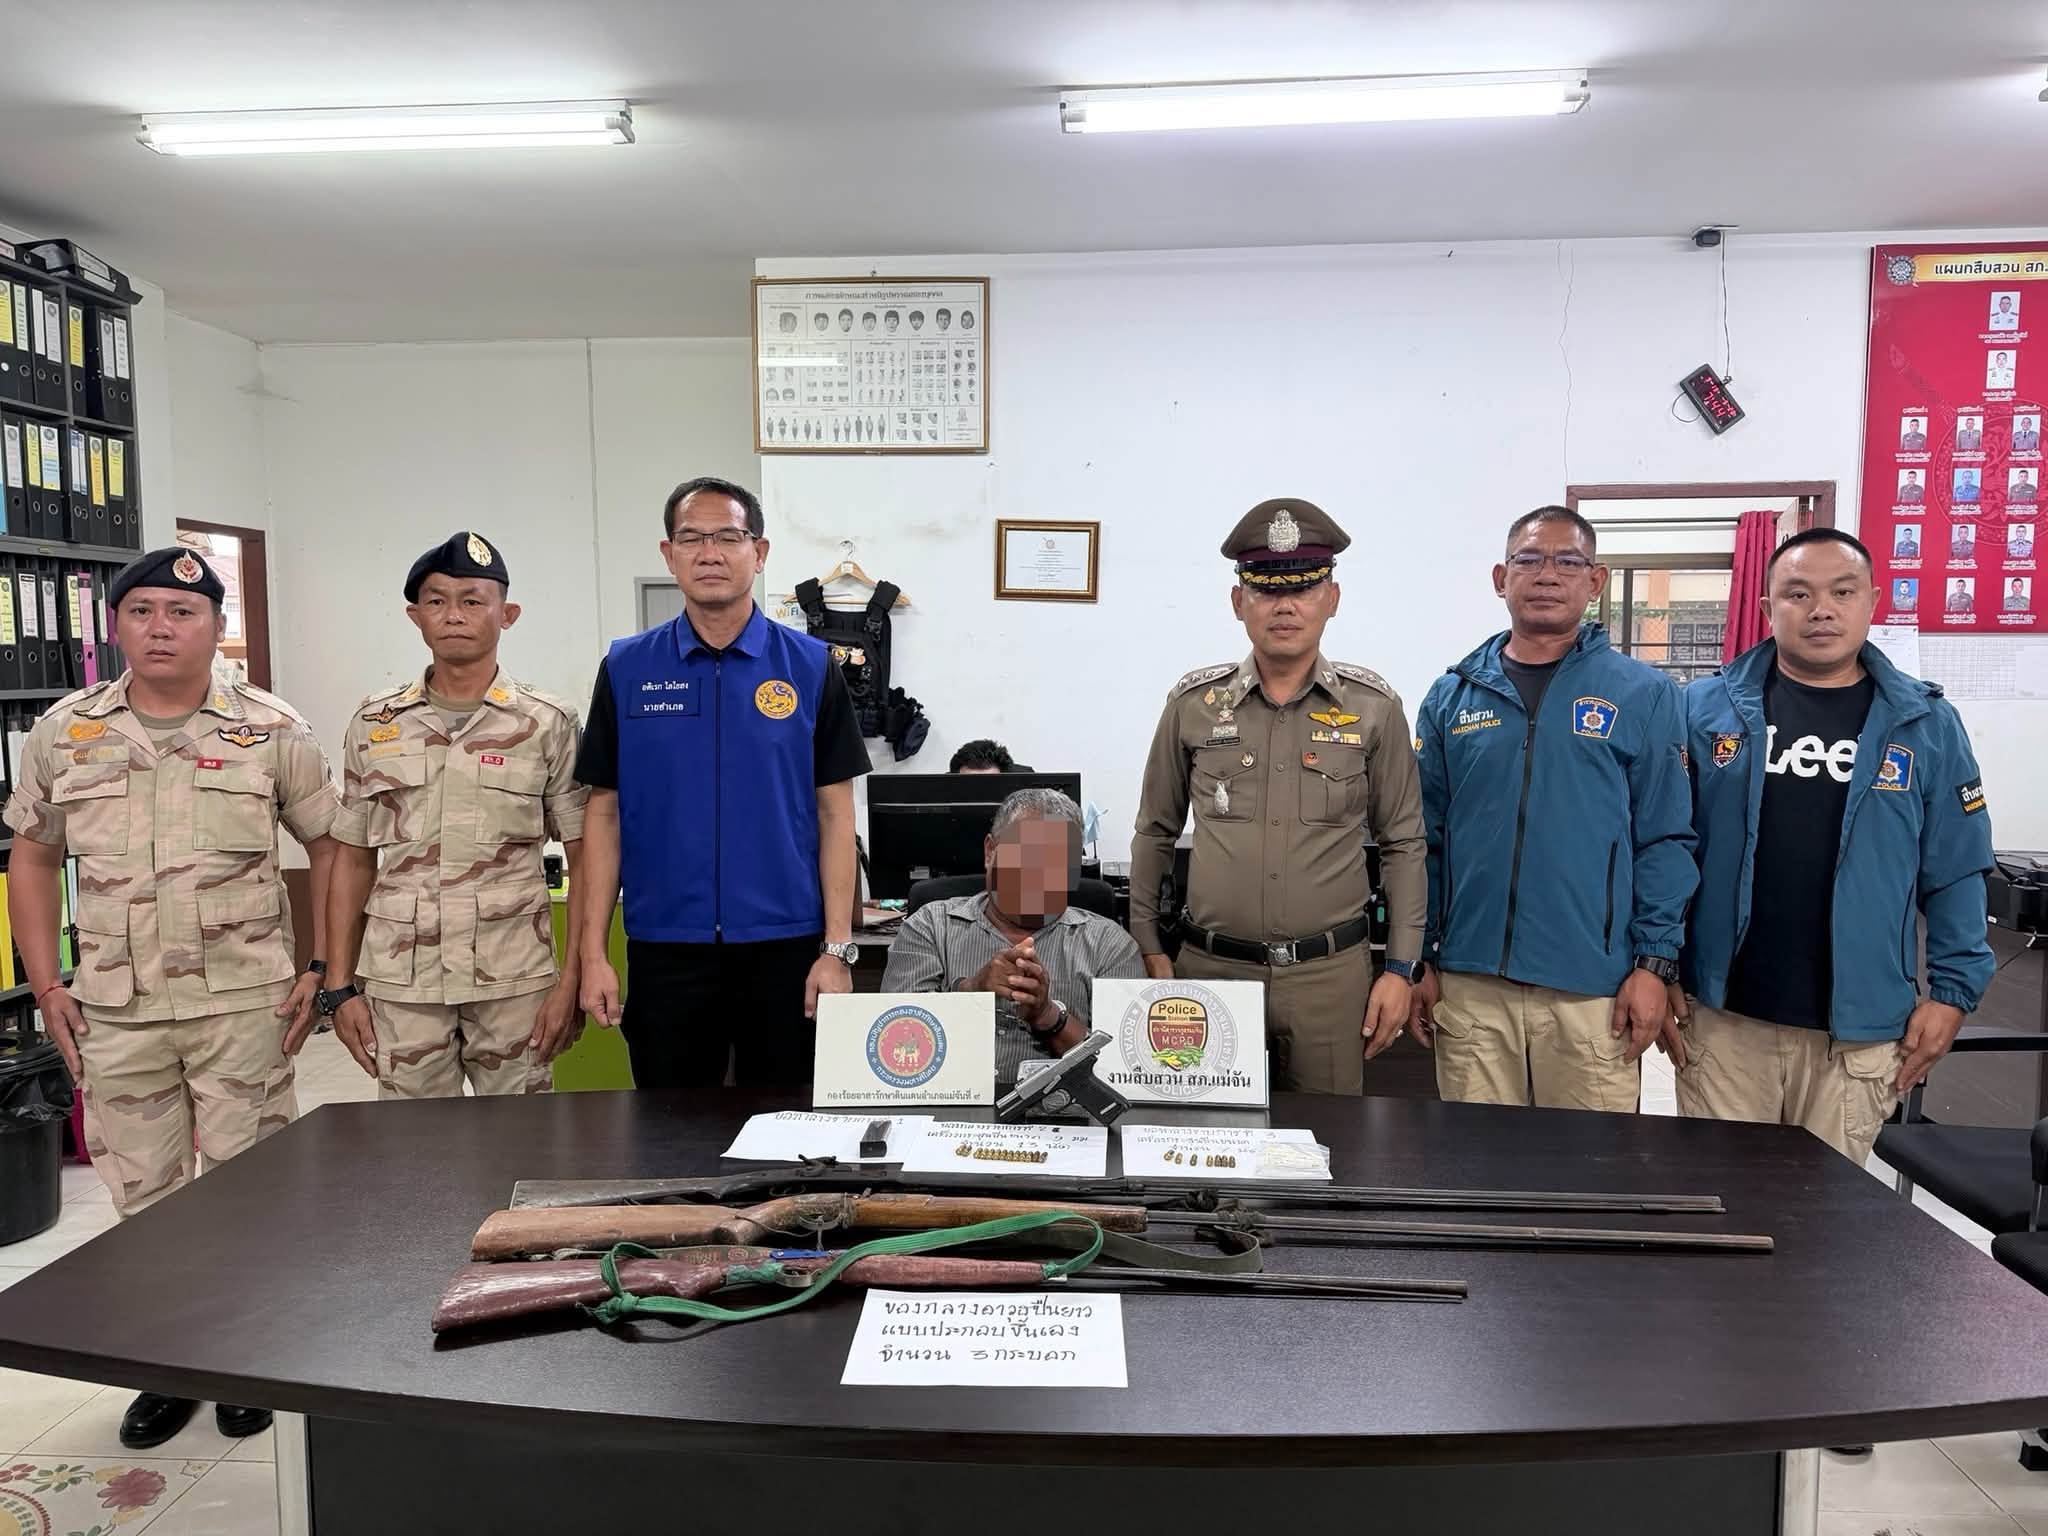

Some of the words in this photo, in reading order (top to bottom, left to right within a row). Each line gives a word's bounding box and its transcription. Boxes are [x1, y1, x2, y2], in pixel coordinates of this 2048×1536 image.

[1934, 260, 2020, 275] แผนกสืบสวน
[643, 701, 684, 712] นายอำเภอ
[1459, 709, 1494, 724] สืบสวน
[1480, 718, 1502, 729] POLICE
[1765, 725, 1858, 783] Lee
[1158, 1003, 1197, 1015] Police
[1108, 1066, 1183, 1086] งานสืบสวน
[1187, 1067, 1252, 1088] สภ.แม่จัน
[878, 1343, 952, 1363] จำนวน
